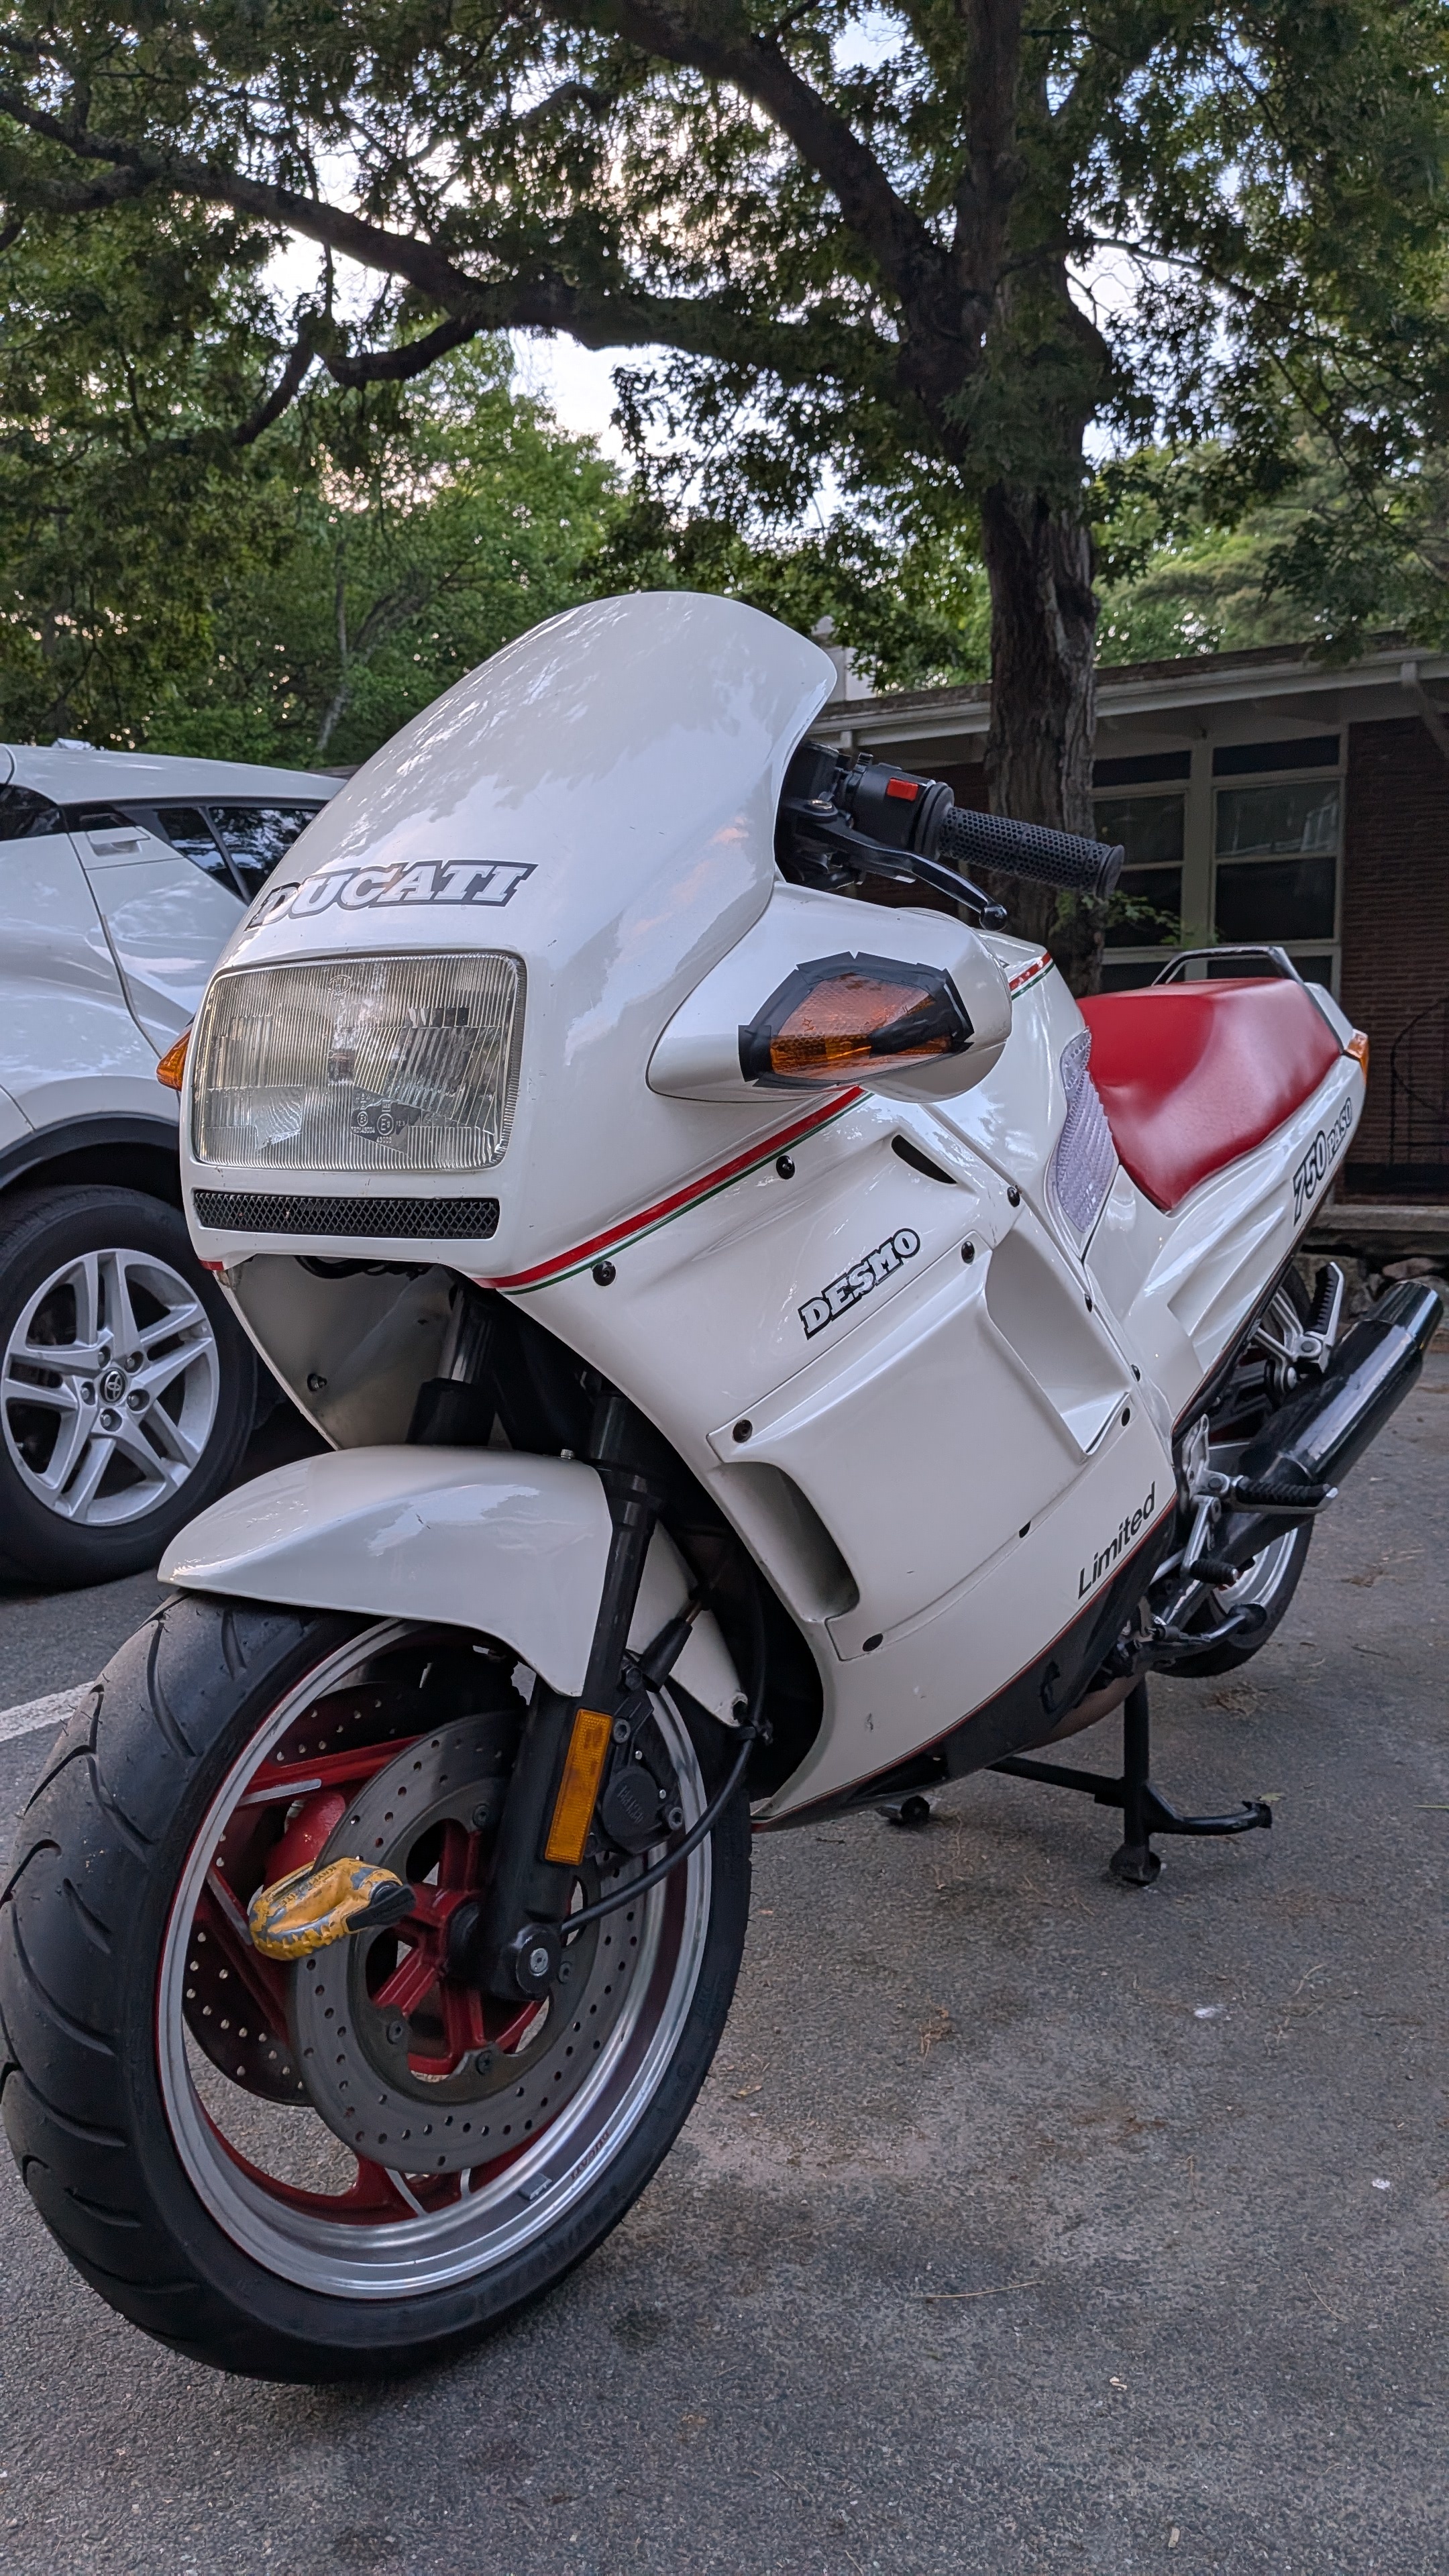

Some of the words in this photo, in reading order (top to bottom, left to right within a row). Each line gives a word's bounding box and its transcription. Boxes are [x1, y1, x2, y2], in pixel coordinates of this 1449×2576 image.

[244, 859, 539, 932] DUCATI
[1293, 1130, 1327, 1227] 750
[1326, 1096, 1352, 1165] PASO
[798, 1228, 920, 1340] DESMO
[1077, 1481, 1155, 1600] Limited
